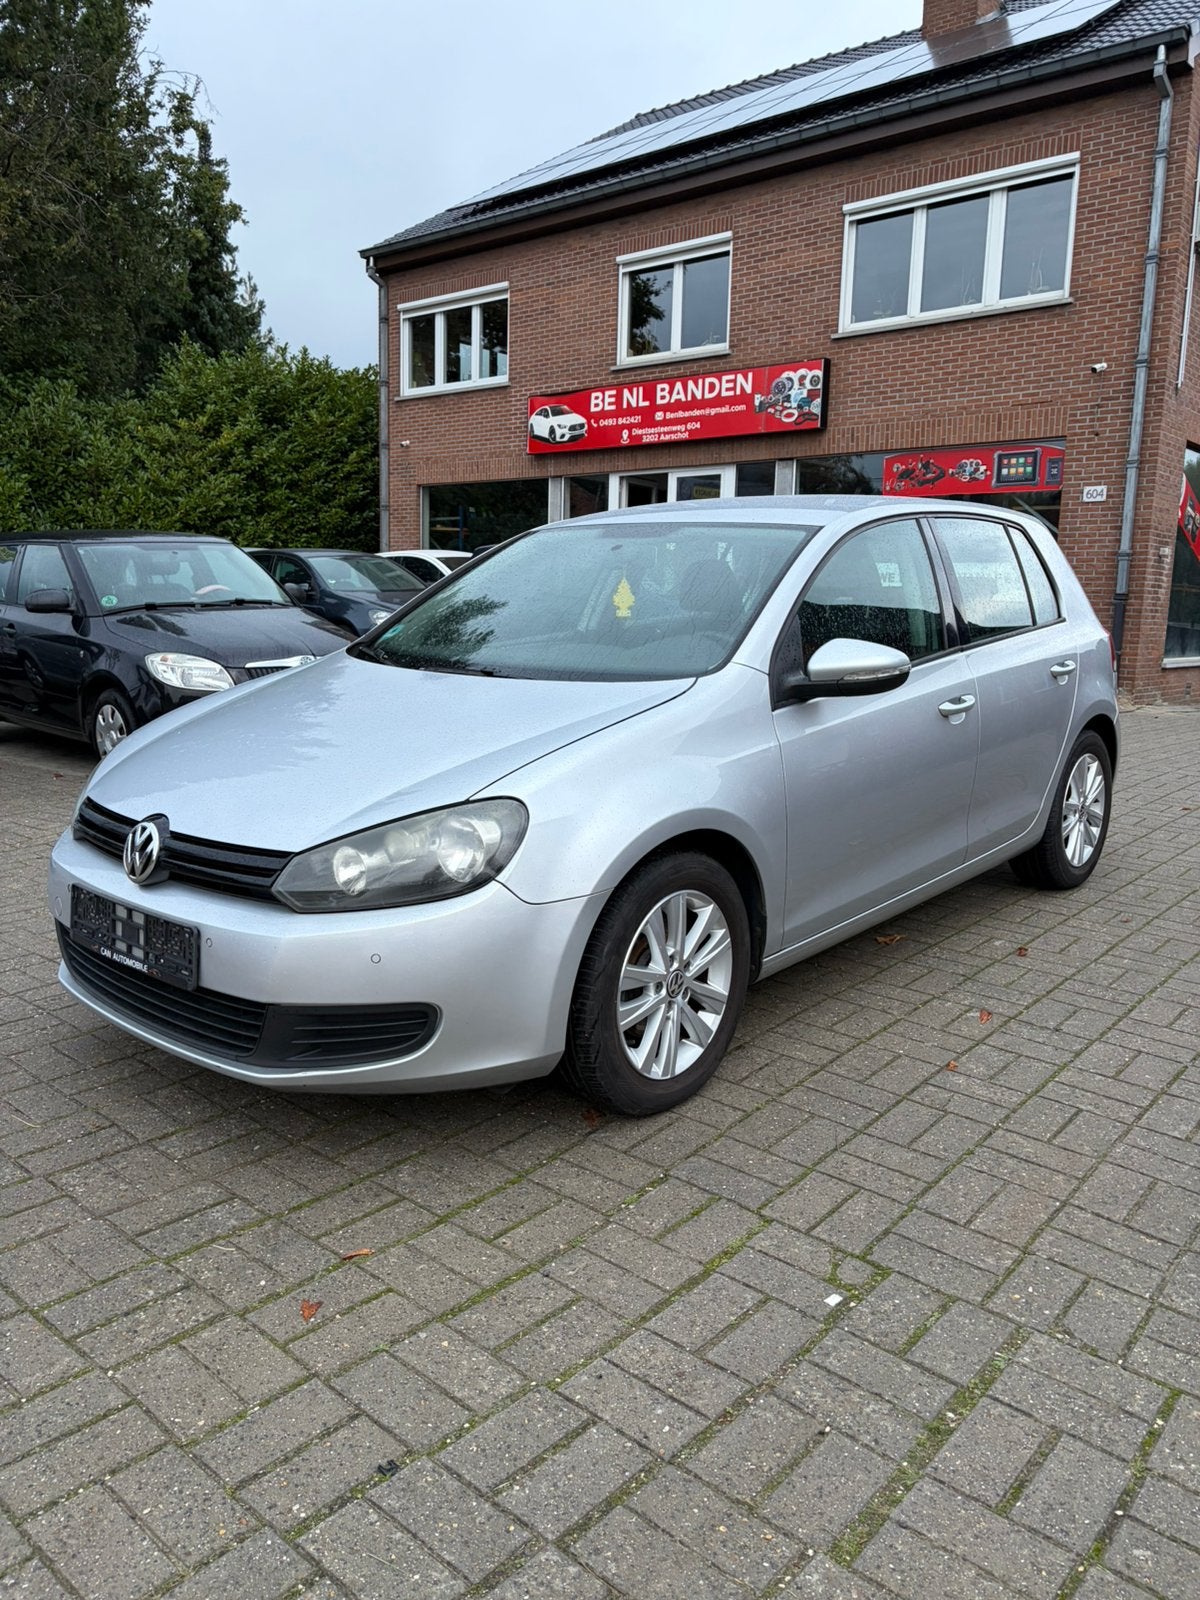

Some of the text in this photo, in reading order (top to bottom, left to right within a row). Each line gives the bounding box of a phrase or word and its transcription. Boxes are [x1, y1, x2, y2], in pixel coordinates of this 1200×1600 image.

[590, 372, 753, 412] BE NL BANDEN
[665, 404, 747, 419] Benlbanden@gmail.com
[599, 415, 642, 427] 0493 842421
[686, 421, 701, 430] 604
[642, 431, 689, 443] 3202 Aarschot
[1085, 488, 1104, 499] 604
[112, 952, 149, 973] AUTOMOBILE
